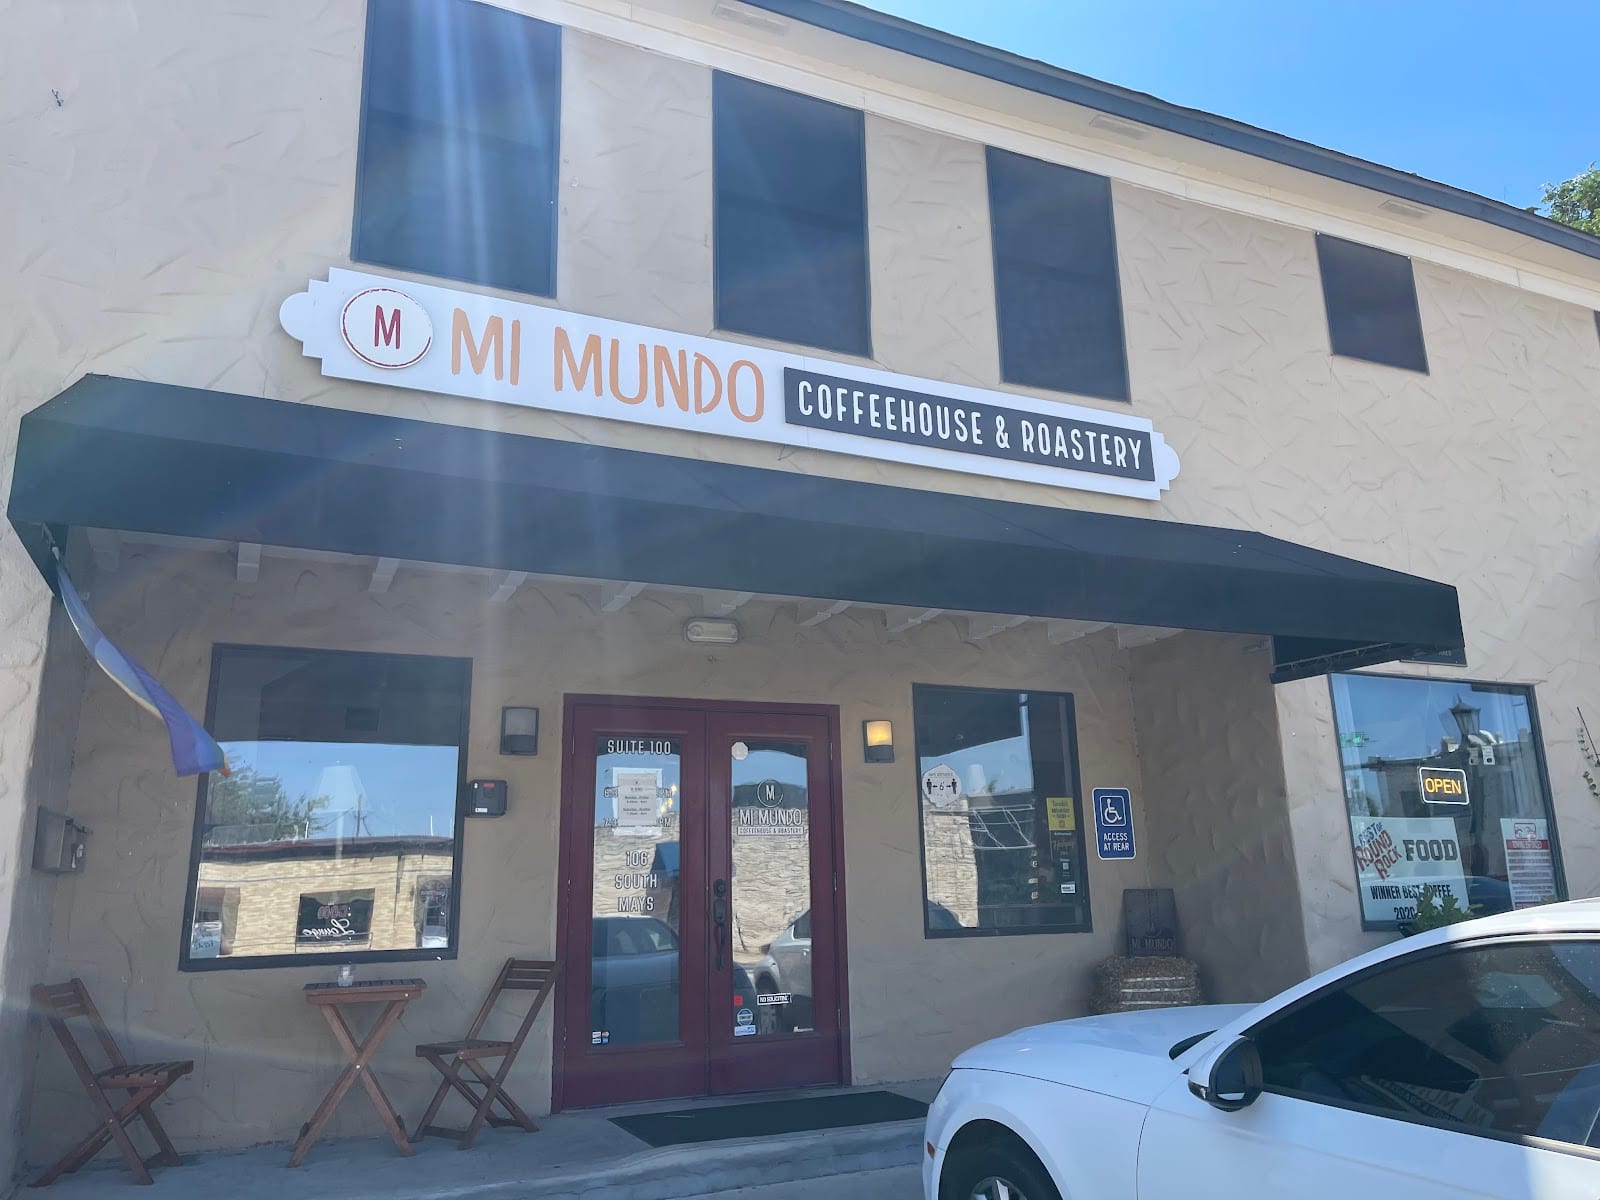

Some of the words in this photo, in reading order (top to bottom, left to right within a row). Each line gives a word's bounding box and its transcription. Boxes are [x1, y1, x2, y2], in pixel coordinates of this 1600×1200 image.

[374, 304, 401, 349] M
[451, 307, 521, 386] MI
[553, 326, 765, 423] MUNDO
[797, 380, 983, 445] COFFEEHOUSE
[995, 415, 1011, 449] &
[1021, 420, 1142, 470] ROASTERY
[607, 739, 644, 754] SUITE
[650, 740, 671, 755] 100
[765, 784, 775, 801] M
[1425, 777, 1462, 795] OPEN
[739, 808, 754, 826] MI
[759, 808, 802, 826] MUNDO
[1103, 832, 1128, 841] ACCESS
[1103, 842, 1111, 852] AT
[1113, 842, 1130, 852] REAR
[1355, 830, 1393, 872] ROUND
[1402, 839, 1457, 861] FOOD
[625, 850, 648, 867] 106
[1374, 845, 1402, 880] ROCK
[614, 873, 658, 890] SOUTH
[1370, 885, 1401, 900] WINNER
[1402, 885, 1420, 899] BEST
[1423, 884, 1452, 899] FFEE
[618, 896, 655, 912] MAYS
